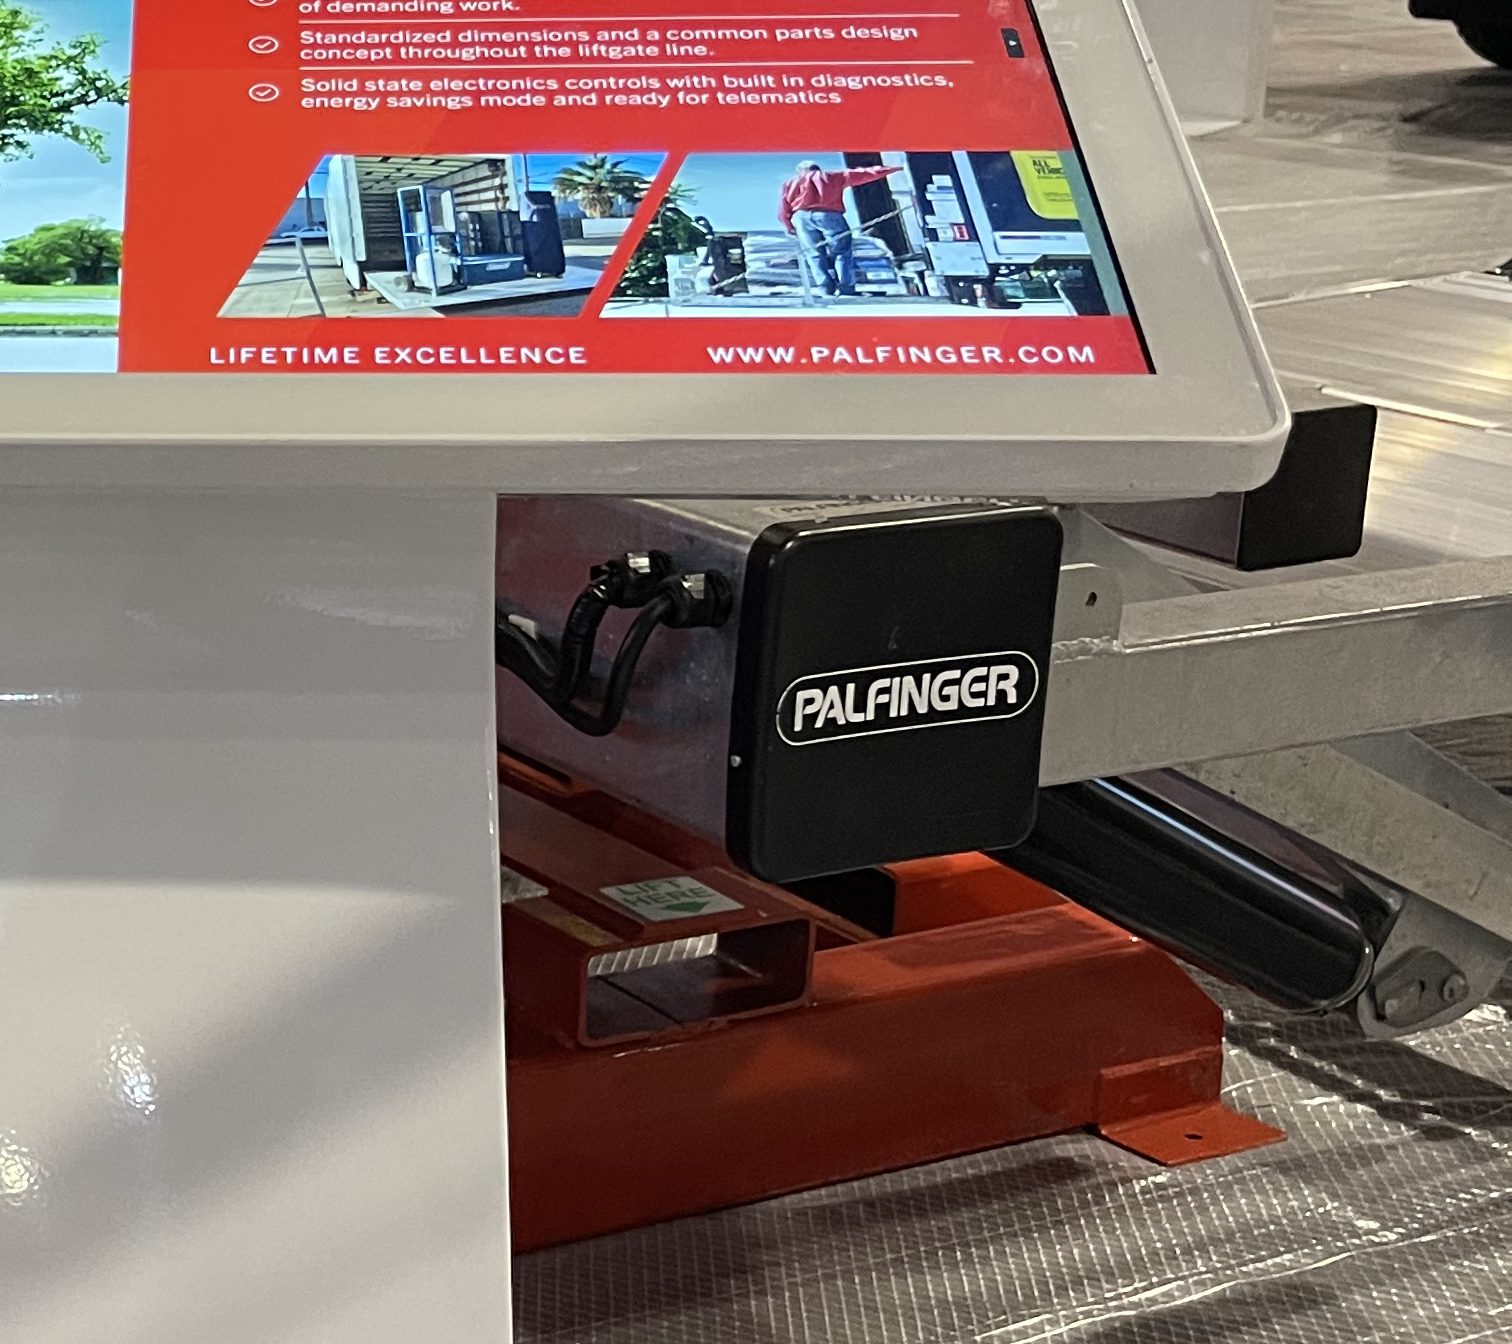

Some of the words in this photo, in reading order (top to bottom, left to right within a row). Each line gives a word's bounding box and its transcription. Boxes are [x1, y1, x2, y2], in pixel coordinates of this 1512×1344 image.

[298, 0, 321, 14] of
[299, 30, 452, 45] Standardized
[458, 28, 590, 43] dimensions
[596, 27, 638, 41] and
[646, 30, 660, 41] a
[666, 27, 768, 40] common
[774, 26, 835, 41] parts
[841, 25, 918, 41] design
[299, 46, 393, 62] concept
[399, 44, 527, 61] throughout
[534, 43, 571, 58] the
[578, 43, 659, 59] liftgate
[665, 42, 716, 57] line.
[300, 78, 358, 92] Solid
[364, 77, 423, 92] state
[429, 76, 558, 91] electronics
[565, 75, 661, 89] controls
[665, 74, 716, 89] with
[722, 74, 777, 88] built
[781, 74, 804, 87] in
[810, 73, 954, 90] diagnostics,
[300, 94, 380, 111] energy
[386, 93, 473, 111] savings
[480, 92, 546, 106] mode
[552, 92, 597, 106] and
[604, 91, 670, 109] ready
[676, 90, 710, 105] for
[716, 90, 842, 105] telematics
[209, 347, 361, 365] LIFETIME
[374, 346, 588, 365] EXCELLENCE
[706, 345, 1096, 364] WWW.PALFINGER.COM
[794, 664, 1019, 732] PALFINGER
[616, 878, 681, 896] LIFT
[622, 886, 717, 907] HERE
